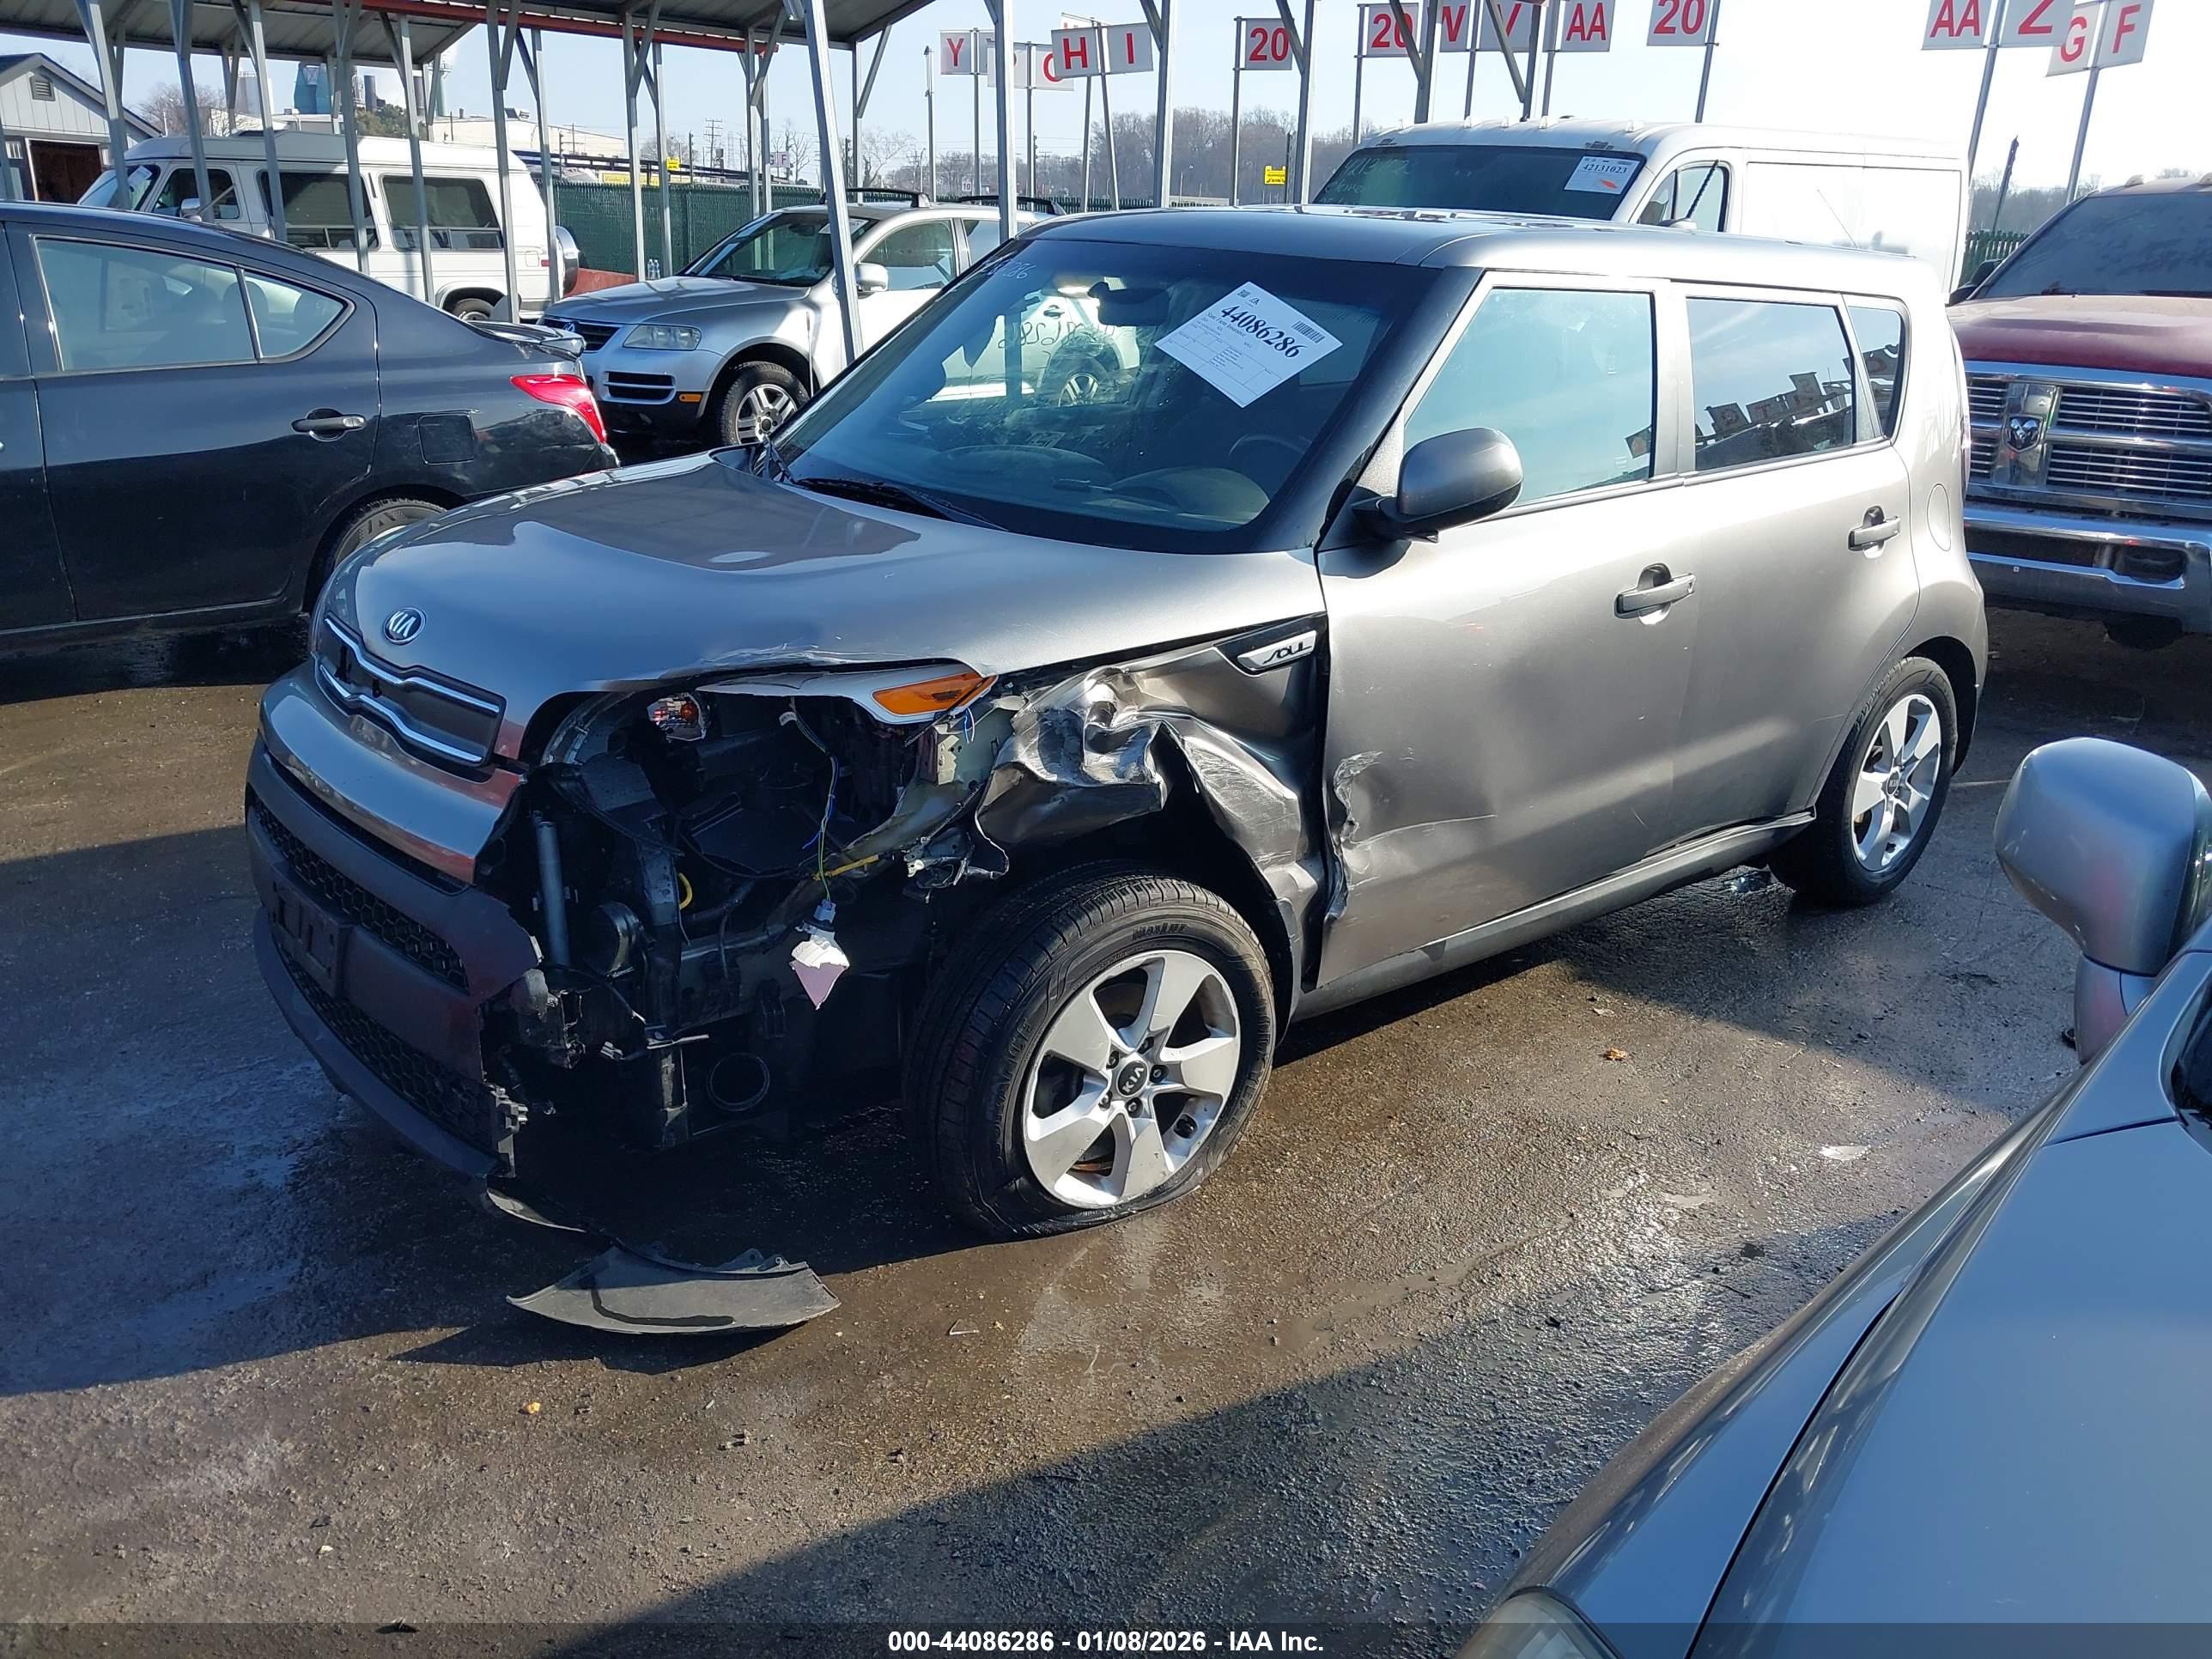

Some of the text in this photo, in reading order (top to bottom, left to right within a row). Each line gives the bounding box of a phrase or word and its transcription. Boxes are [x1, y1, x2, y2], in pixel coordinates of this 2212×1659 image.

[1371, 13, 1413, 48] 20
[1565, 3, 1607, 41] AA
[1653, 0, 1705, 34] 20
[1930, 0, 1980, 37] AA
[2061, 4, 2141, 62] G F
[947, 38, 963, 66] Y
[1062, 33, 1133, 69] H I
[1249, 27, 1290, 61] 20
[1221, 305, 1309, 358] 44086286
[388, 611, 417, 637] KIA
[1262, 641, 1312, 665] SOUL
[1122, 1067, 1145, 1093] KIA
